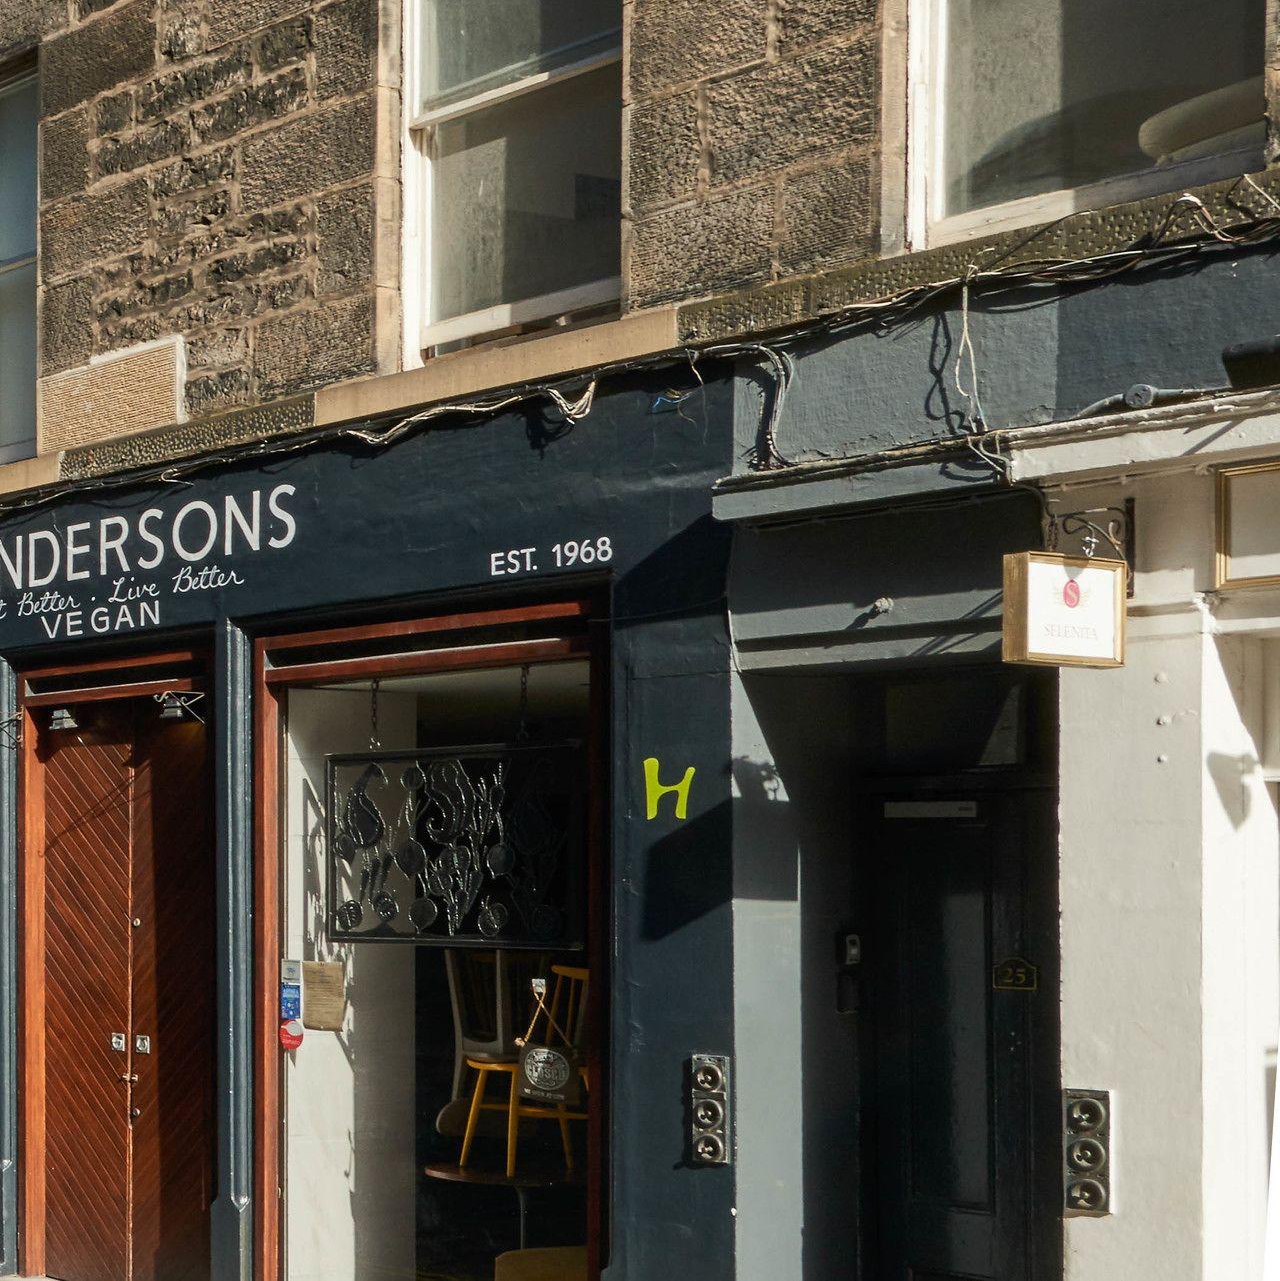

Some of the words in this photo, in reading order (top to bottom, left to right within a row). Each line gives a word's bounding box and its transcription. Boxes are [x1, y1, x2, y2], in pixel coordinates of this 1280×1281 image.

[490, 547, 538, 576] EST.
[551, 536, 613, 567] 1968
[17, 591, 82, 618] Better
[107, 576, 160, 604] Live
[171, 565, 245, 593] Better
[40, 600, 161, 639] VEGAN
[643, 757, 696, 820] H
[1001, 967, 1026, 984] 25
